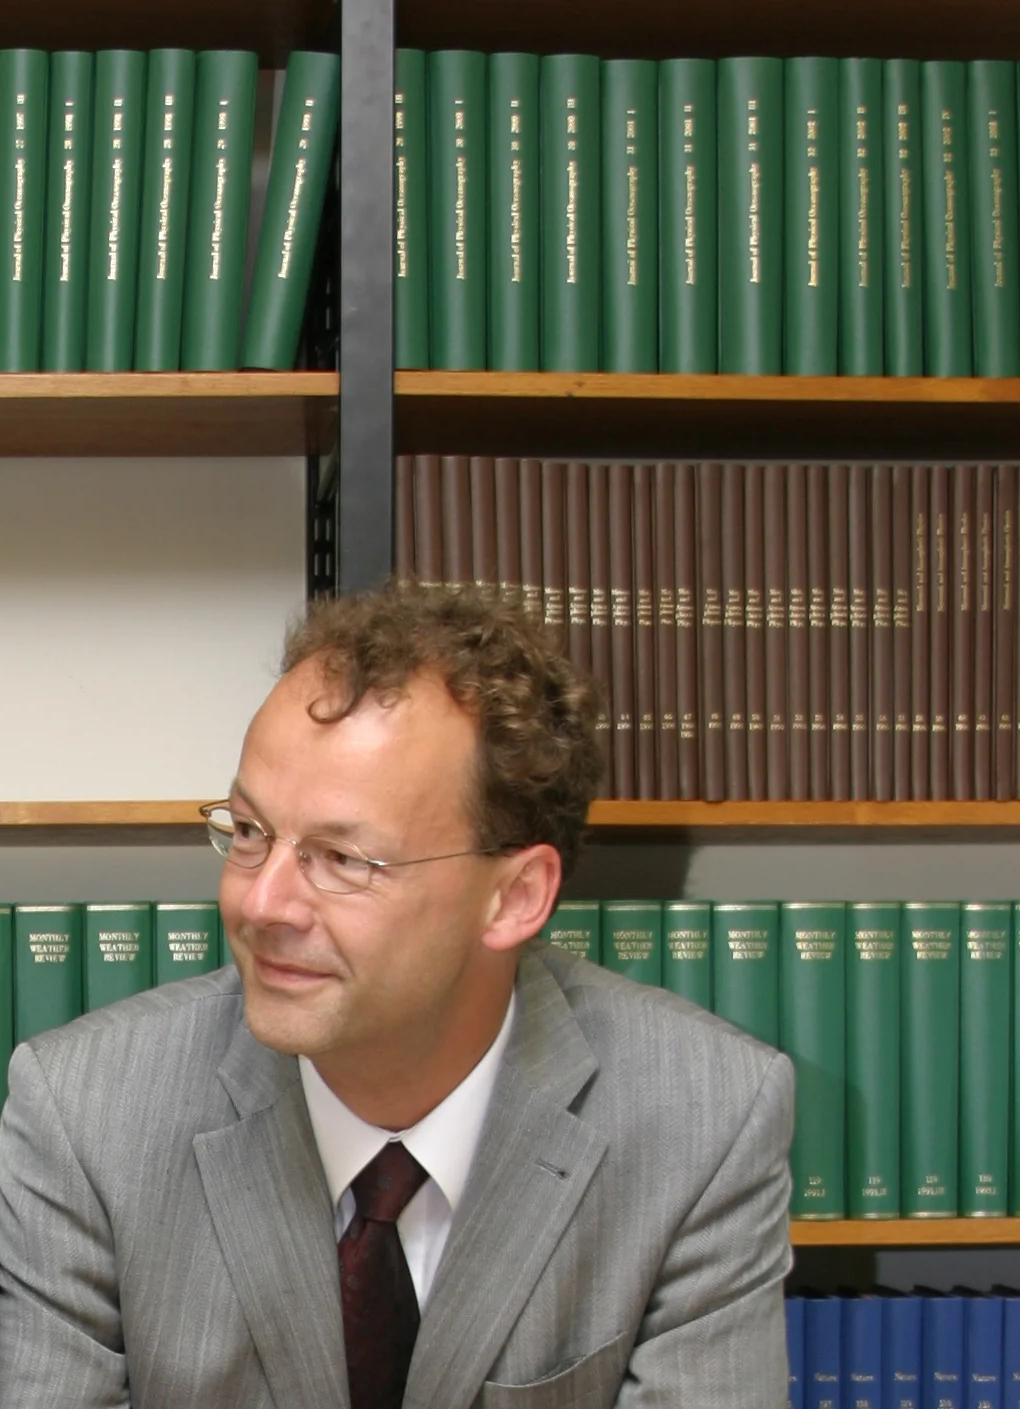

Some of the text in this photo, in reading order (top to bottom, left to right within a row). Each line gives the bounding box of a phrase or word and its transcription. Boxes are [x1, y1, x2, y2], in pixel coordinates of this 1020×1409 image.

[396, 156, 407, 207] Oceanography
[510, 160, 521, 211] Oceanography
[566, 161, 577, 212] Oceanography
[684, 165, 695, 215] Oceanography
[277, 251, 289, 279] Journal
[283, 209, 296, 241] Physical
[290, 158, 306, 209] Oceanography
[396, 208, 407, 239] Physical
[510, 212, 521, 243] Physical
[566, 213, 577, 244] Physical
[684, 216, 695, 247] Physical
[397, 250, 407, 277] Journal
[511, 254, 521, 282] Journal
[566, 255, 576, 283] Journal
[685, 258, 695, 285] Journal
[29, 934, 69, 943] MONTHLY
[99, 933, 139, 942] MONTHLY
[168, 932, 208, 942] MONTHLY
[613, 931, 653, 940] MONTHLY
[669, 931, 707, 940] MONTHLY
[728, 931, 767, 940] MONTHLY
[795, 931, 834, 940] MONTHLY
[912, 931, 950, 940] MONTHLY
[30, 944, 68, 953] WEATHER
[99, 944, 139, 953] WEATHER
[168, 943, 208, 952] WEATHER
[615, 942, 653, 951] WEATHER
[669, 942, 707, 951] WEATHER
[728, 942, 767, 951] WEATHER
[796, 942, 834, 951] WEATHER
[912, 942, 951, 951] WEATHER
[34, 955, 66, 963] REVIEW
[103, 954, 135, 962] REVIEW
[173, 953, 204, 961] REVIEW
[618, 951, 650, 959] REVIEW
[671, 951, 704, 959] REVIEW
[732, 951, 763, 959] REVIEW
[800, 951, 831, 959] REVIEW
[916, 951, 947, 959] REVIEW
